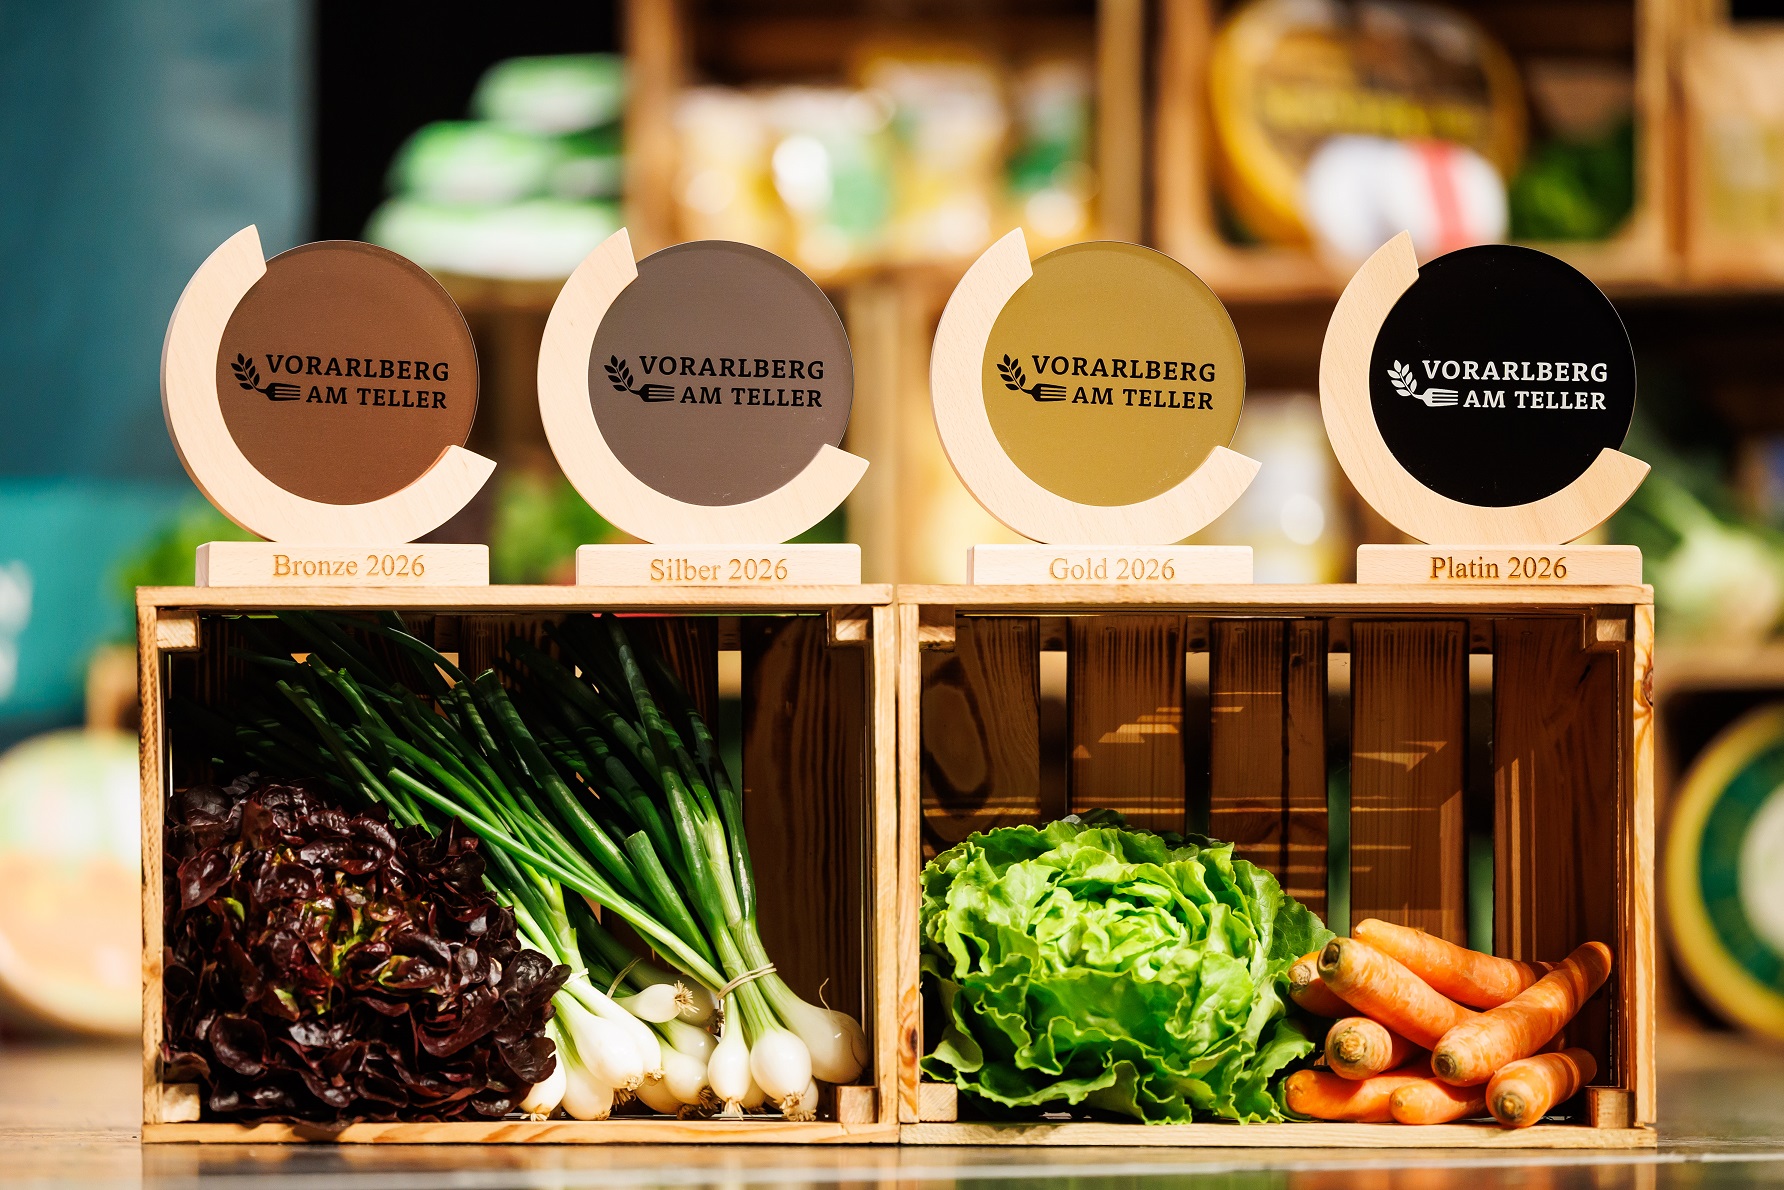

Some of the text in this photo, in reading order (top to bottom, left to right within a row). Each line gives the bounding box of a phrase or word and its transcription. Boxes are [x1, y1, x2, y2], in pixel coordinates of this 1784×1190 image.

[266, 354, 448, 381] VORARLBERG
[639, 356, 823, 379] VORARLBERG
[1032, 355, 1215, 382] VORARLBERG
[1422, 360, 1607, 382] VORARLBERG
[306, 386, 447, 409] AM TELLER
[680, 386, 822, 407] AM TELLER
[1072, 387, 1213, 410] AM TELLER
[1463, 390, 1606, 409] AM TELLER
[273, 555, 424, 577] Bronze 2026
[651, 559, 787, 582] Silber 2026
[1049, 558, 1175, 581] Gold 2026
[1430, 557, 1566, 580] Platin 2026
